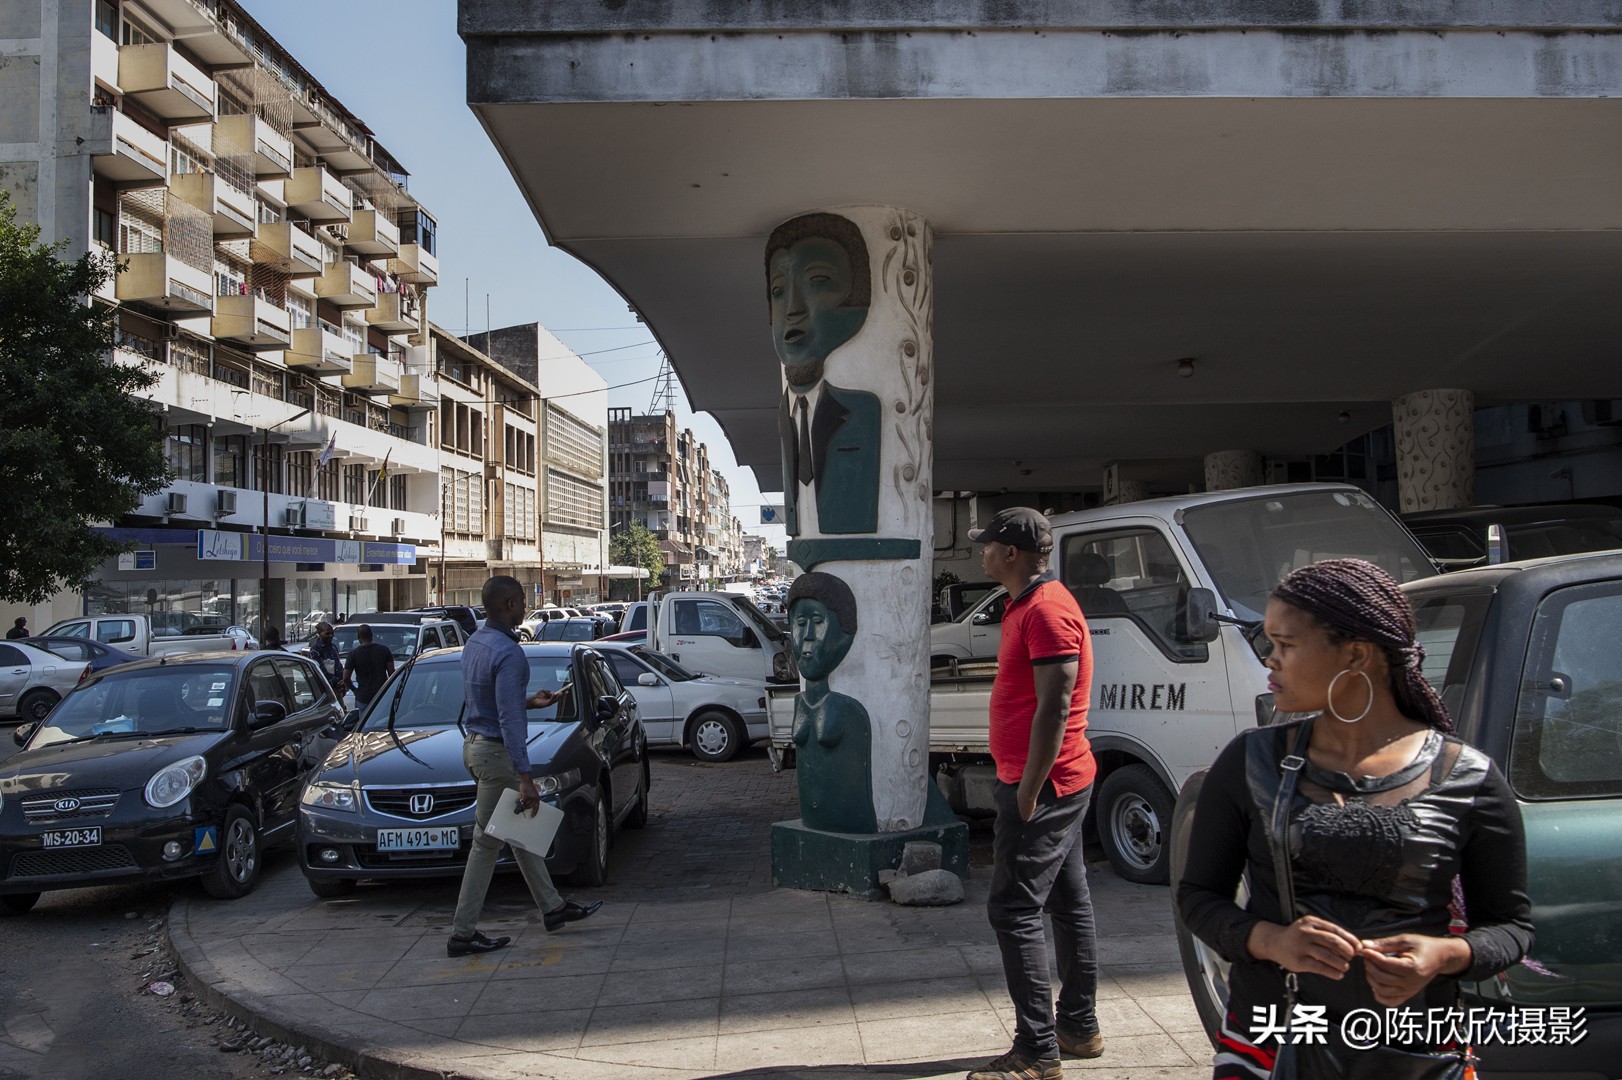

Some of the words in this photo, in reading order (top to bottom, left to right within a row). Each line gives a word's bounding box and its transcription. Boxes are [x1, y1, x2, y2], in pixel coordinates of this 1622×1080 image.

[256, 541, 262, 553] O
[282, 545, 291, 557] que
[1099, 682, 1186, 711] MIREM
[379, 832, 403, 848] AFM
[407, 831, 430, 846] 491
[441, 830, 457, 845] MC
